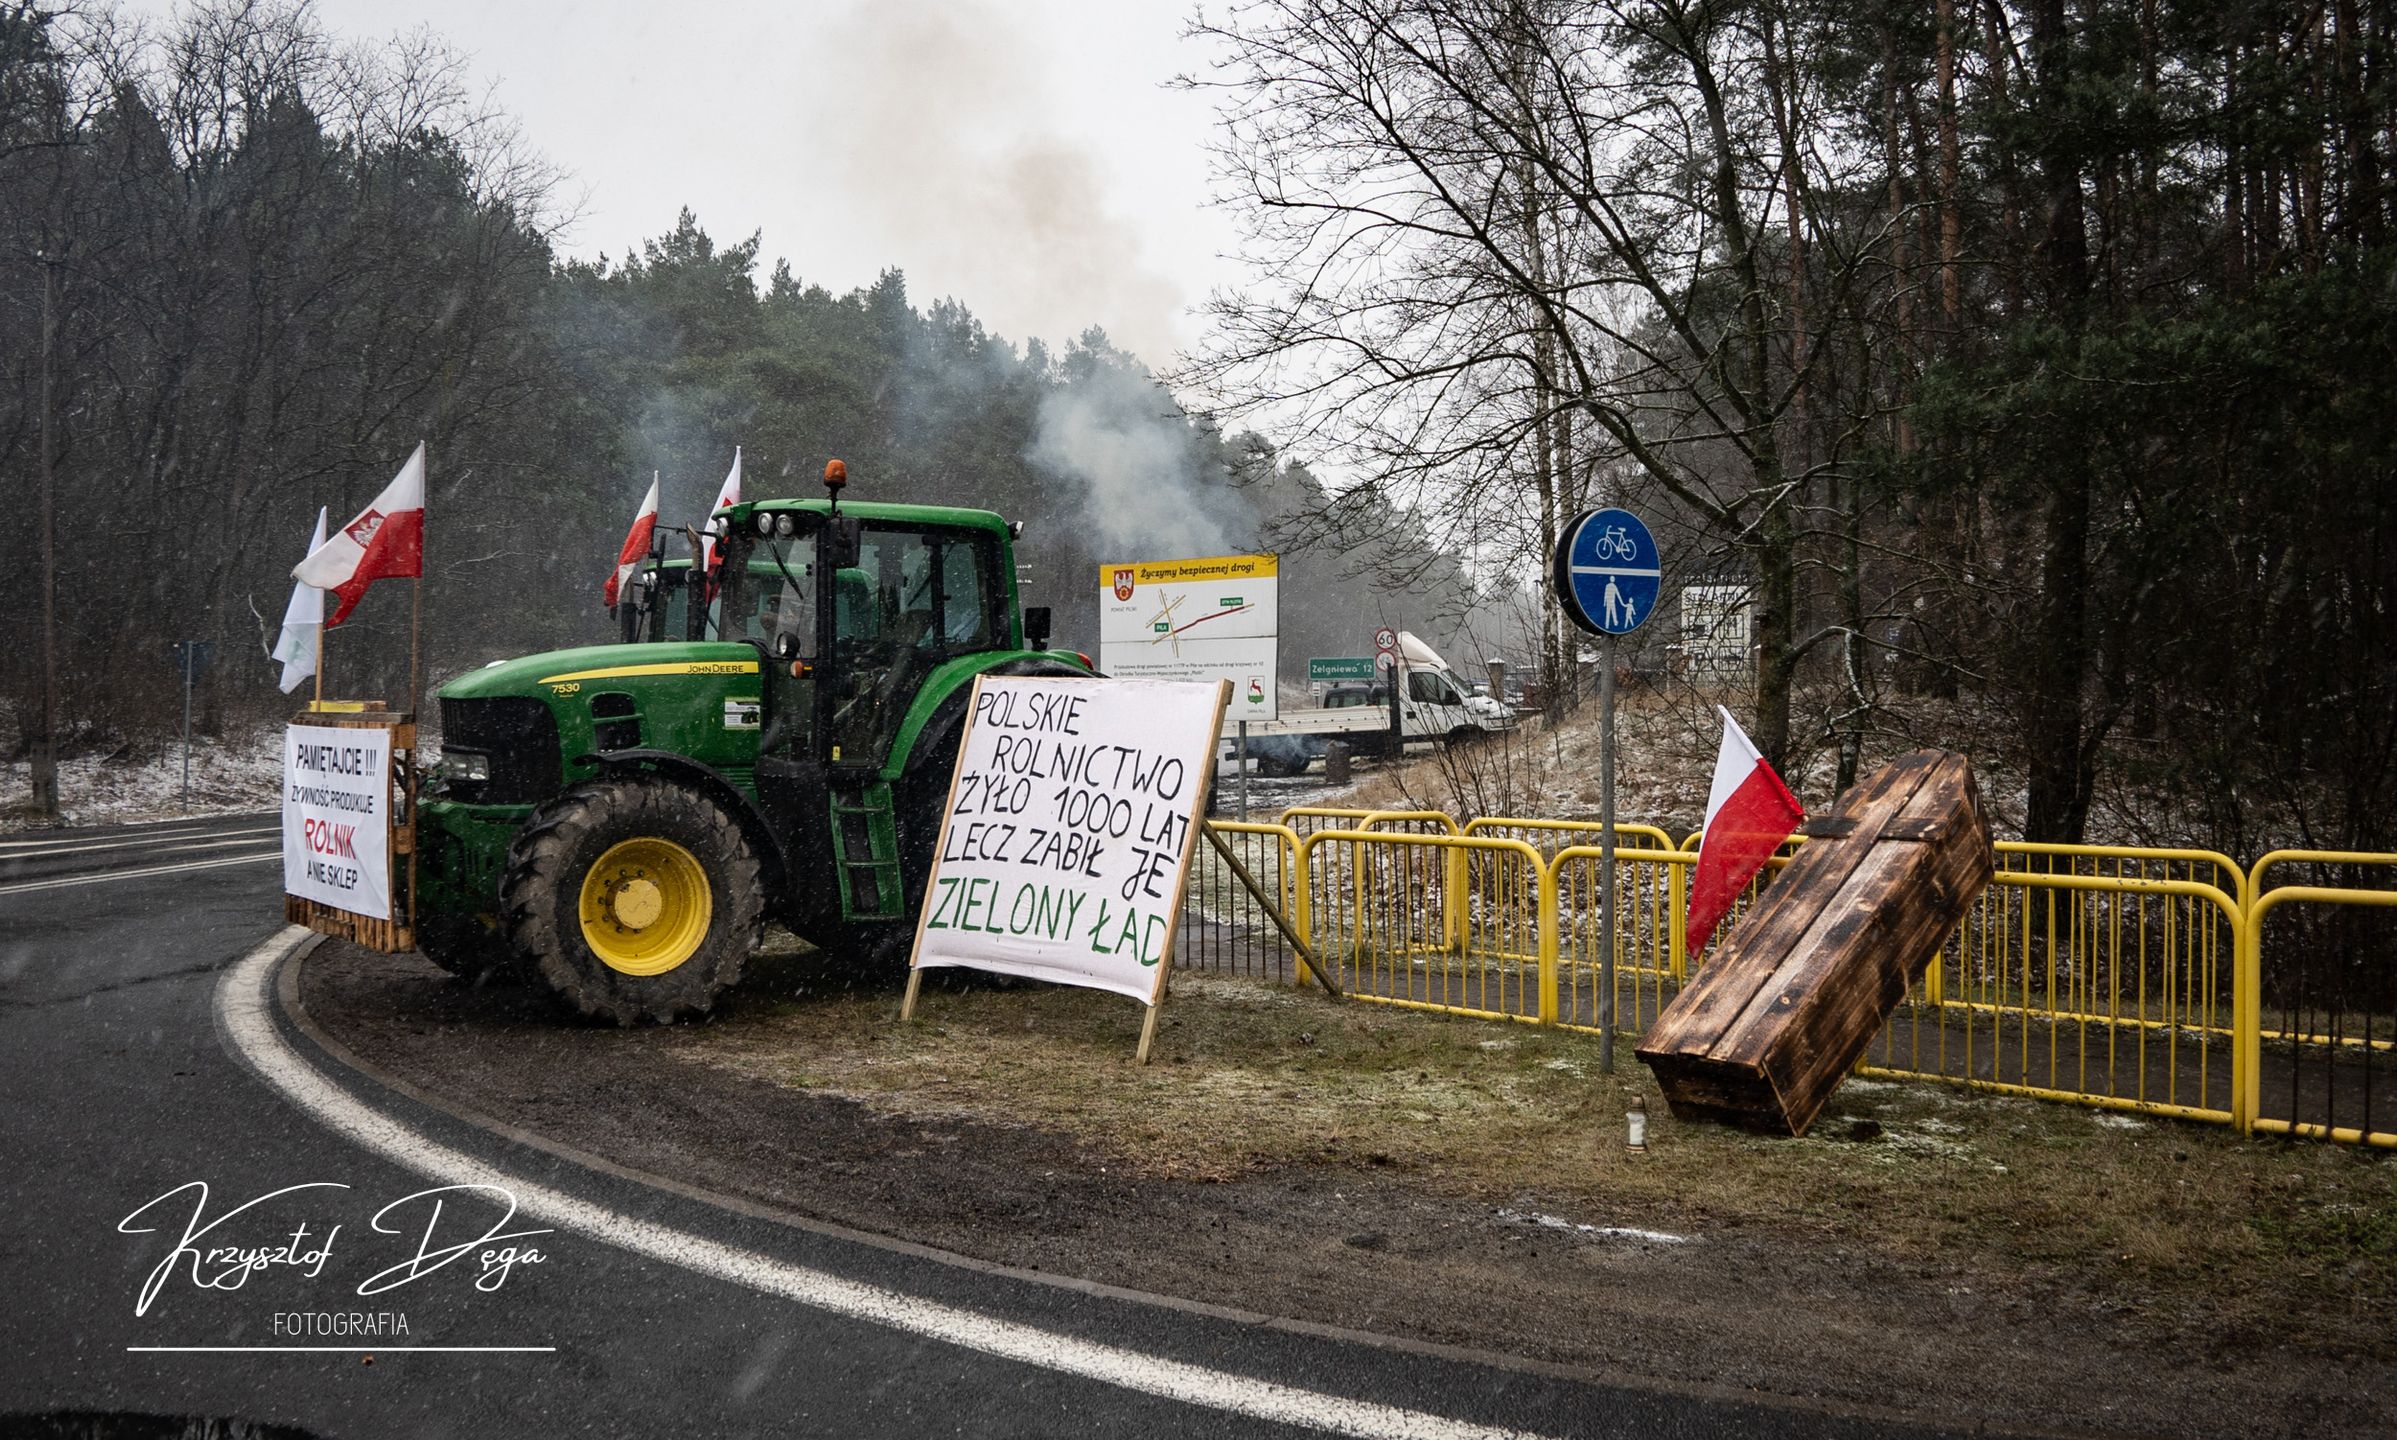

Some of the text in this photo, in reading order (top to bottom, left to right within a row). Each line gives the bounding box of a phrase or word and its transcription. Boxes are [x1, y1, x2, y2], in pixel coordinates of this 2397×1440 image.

[1141, 562, 1255, 580] Życzymy bezpiecznej drogi
[1378, 634, 1393, 645] 60
[687, 664, 744, 673] JOHN DEERE
[1363, 664, 1372, 673] 12
[551, 682, 581, 694] 7530
[972, 690, 1088, 735] POLSKIE
[296, 743, 377, 778] PAMIĘTAJCIE !!!
[991, 735, 1184, 801] ROLNICTWO
[292, 780, 373, 814] ŻYWNOŚĆ PRODUKUJE
[954, 769, 1190, 858] ŻYŁO 1000 LAT
[304, 818, 356, 860] ROLNIK
[307, 860, 358, 891] A NIE SKLEP
[942, 823, 1175, 902] LECZ ZABIŁ JE
[927, 876, 1167, 967] ZIELONY ŁAD
